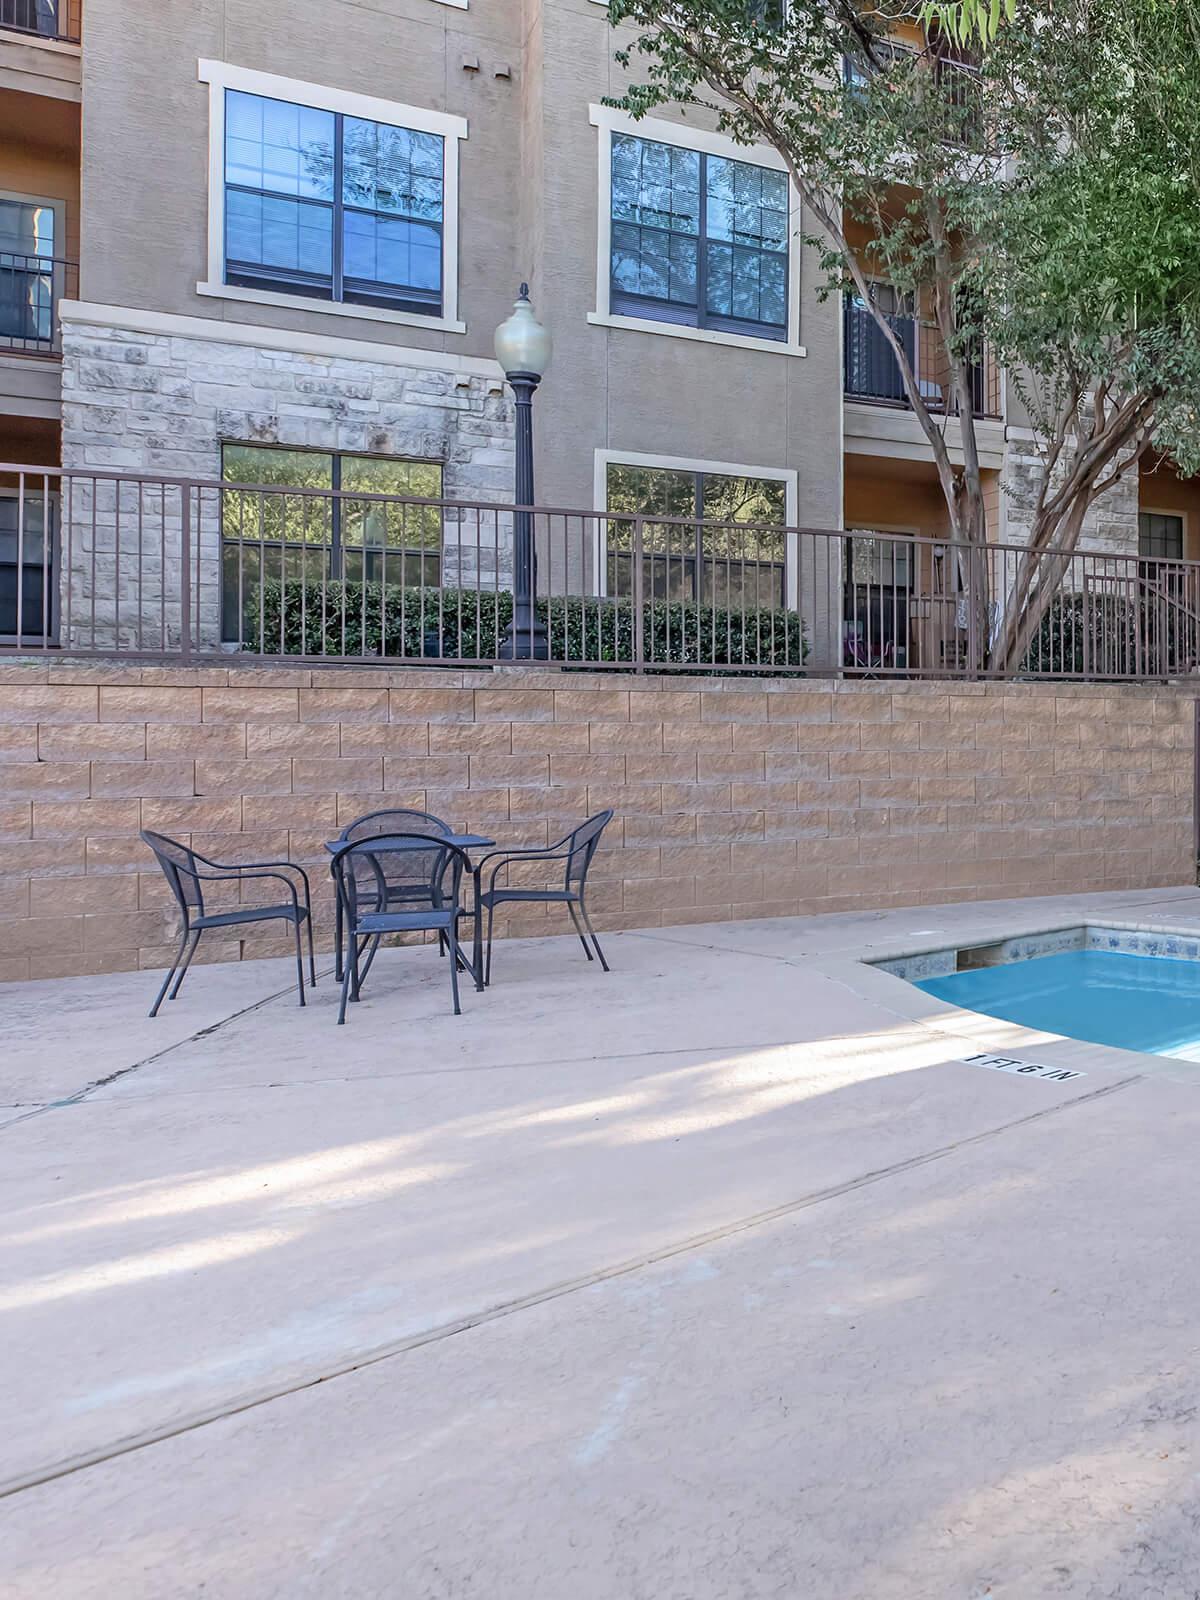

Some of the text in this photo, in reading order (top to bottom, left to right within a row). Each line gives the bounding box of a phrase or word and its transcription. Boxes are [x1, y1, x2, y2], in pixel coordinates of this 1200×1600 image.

[964, 1054, 1080, 1081] 1 FT 6 IN
